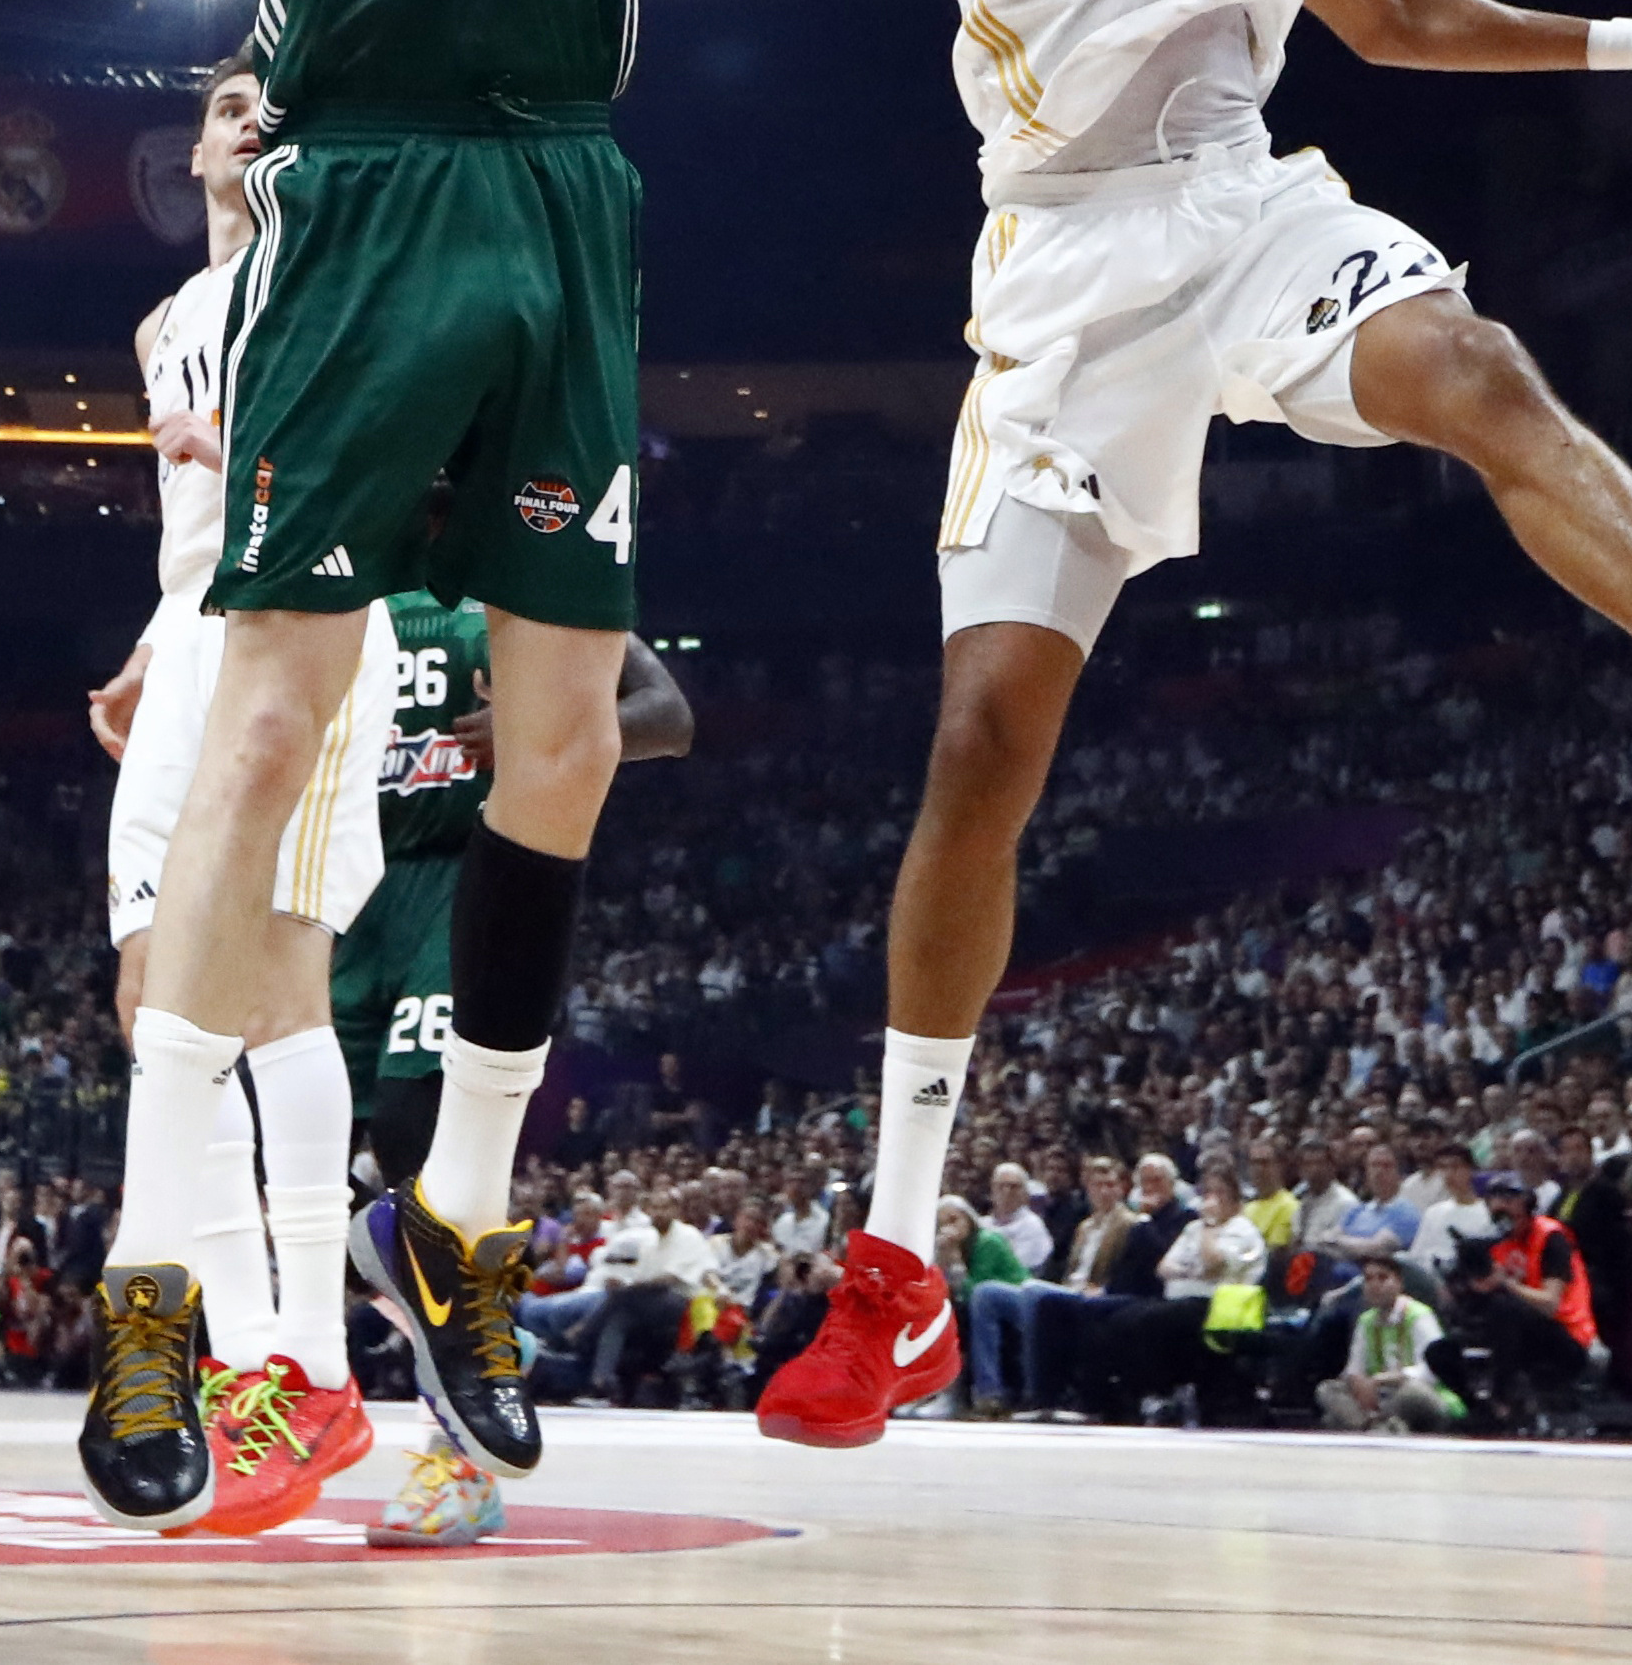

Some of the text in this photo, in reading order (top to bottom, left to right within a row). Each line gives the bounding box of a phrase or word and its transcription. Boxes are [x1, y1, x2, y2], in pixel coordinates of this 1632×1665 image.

[181, 344, 210, 412] 11
[236, 455, 274, 574] instacar
[513, 495, 581, 515] FINAL FOUR
[585, 464, 633, 565] 4
[396, 647, 448, 708] 26
[388, 994, 452, 1053] 26
